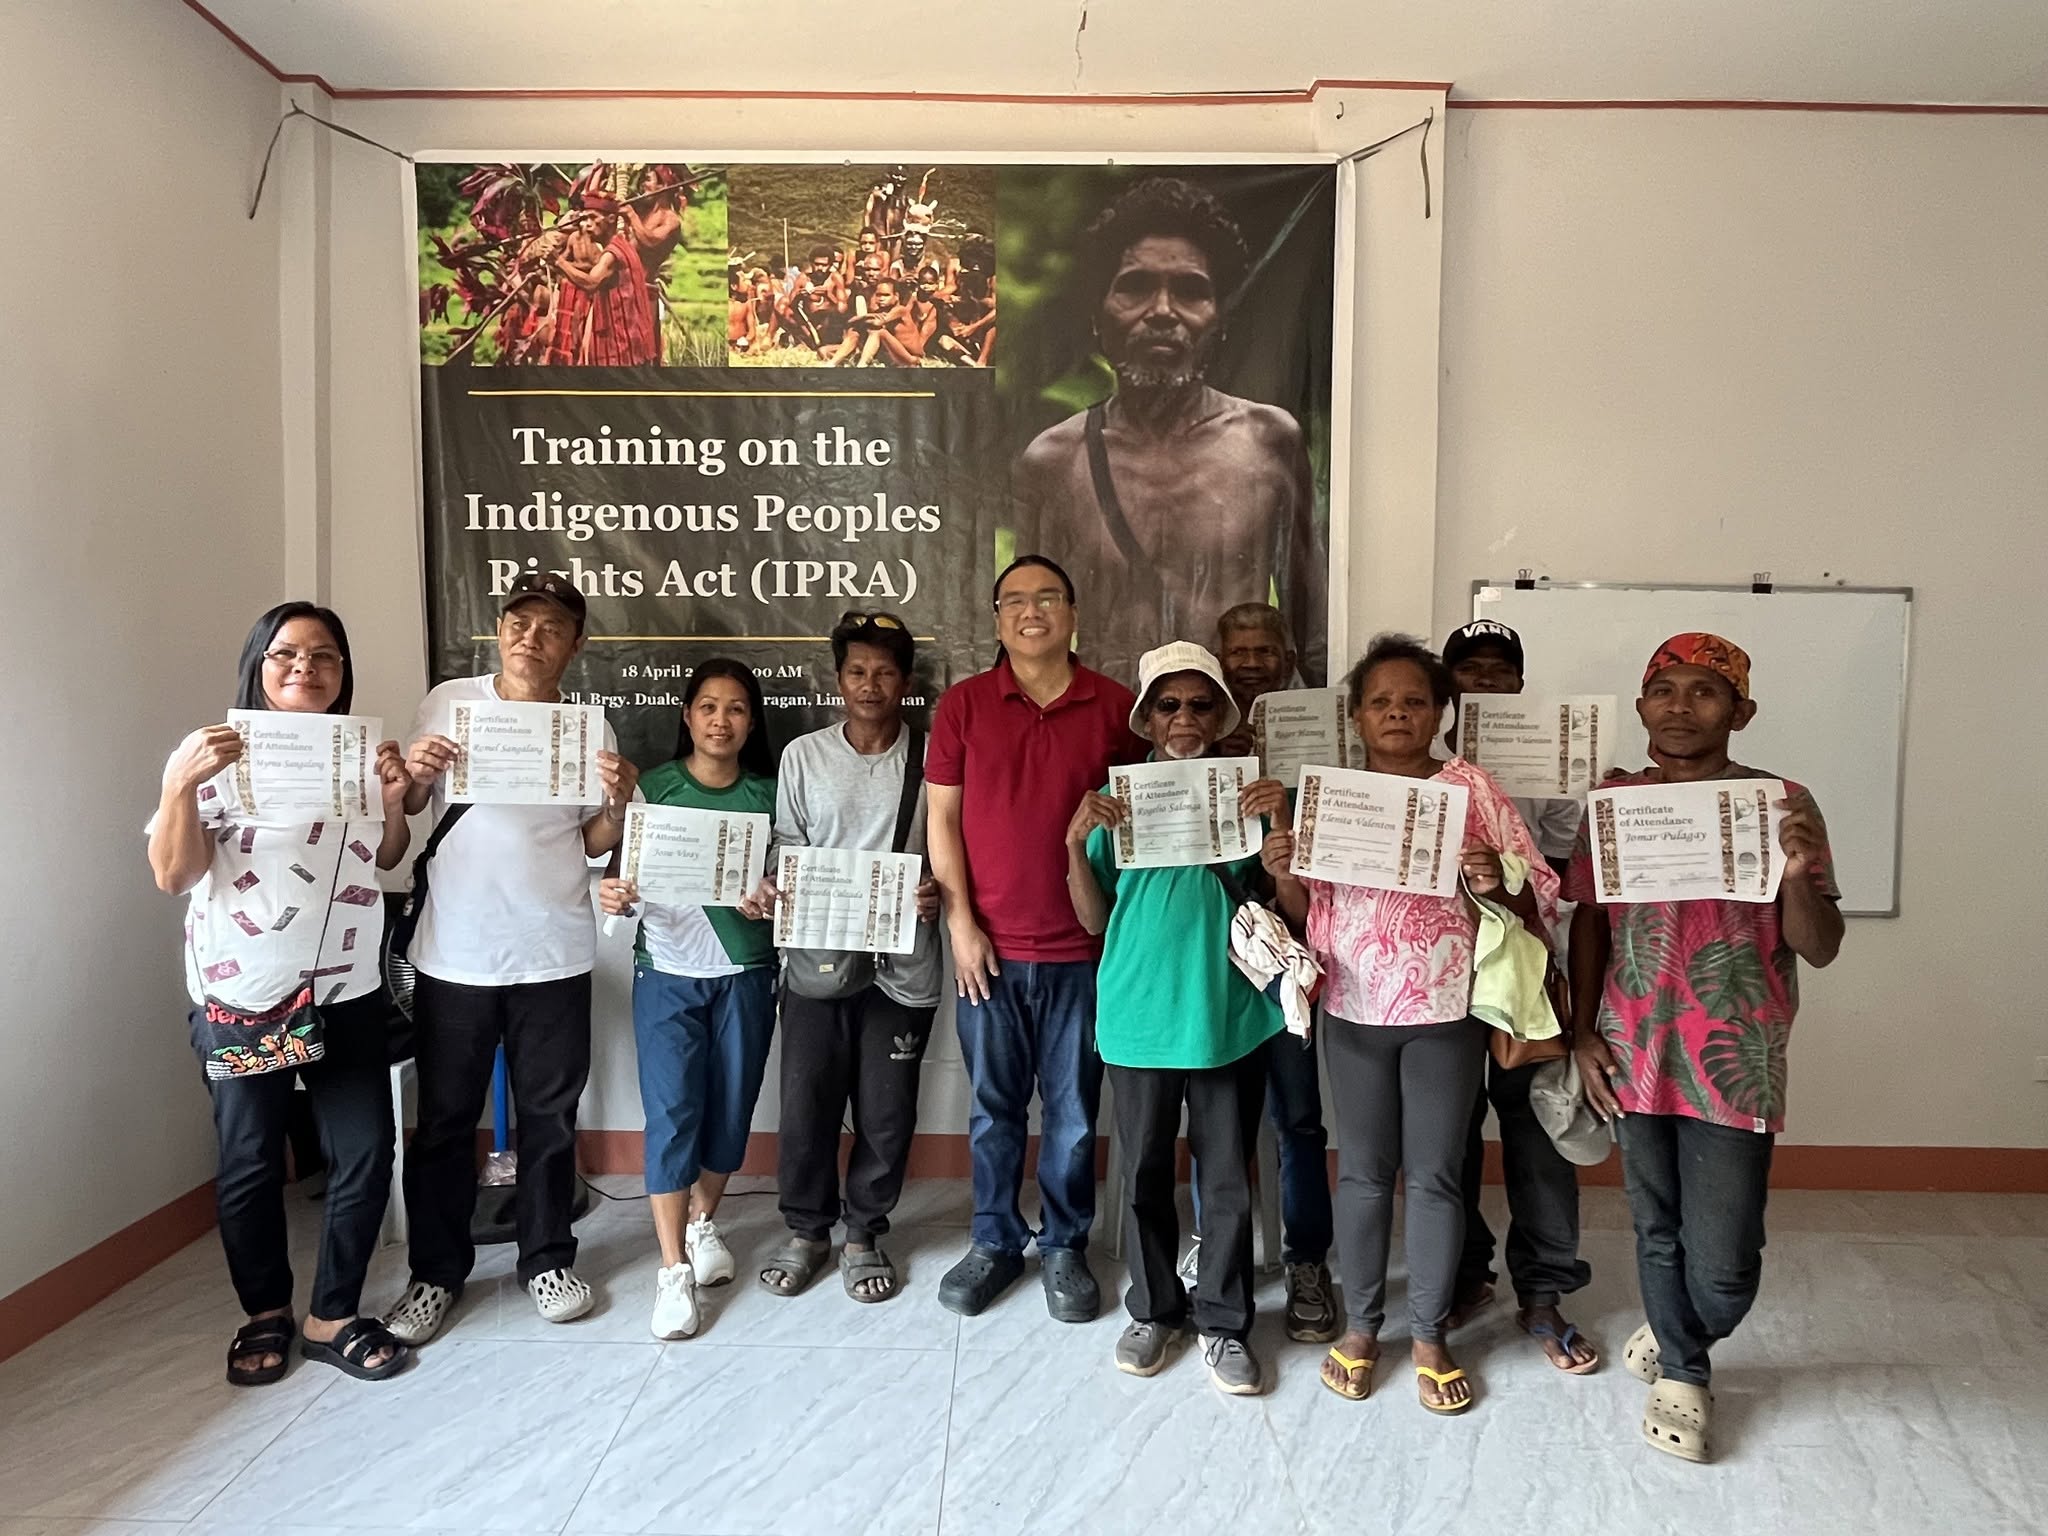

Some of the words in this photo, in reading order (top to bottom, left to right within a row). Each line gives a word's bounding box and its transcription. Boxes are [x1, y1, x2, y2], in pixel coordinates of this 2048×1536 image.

[512, 425, 726, 476] Training
[738, 437, 800, 466] on
[812, 427, 892, 466] the
[464, 491, 739, 541] Indigenous
[753, 493, 941, 542] Peoples
[656, 559, 737, 597] Act
[751, 558, 918, 604] (IPRA)
[622, 665, 638, 677] 18
[642, 665, 681, 680] April
[776, 665, 802, 678] AM
[590, 692, 630, 708] Brgy.
[474, 715, 518, 724] Certificate
[485, 726, 532, 735] Attendance
[1133, 780, 1176, 790] Certificate
[1145, 788, 1189, 799] Attendance
[1323, 786, 1370, 799] Certificate
[1321, 798, 1331, 806] of
[1333, 799, 1384, 813] Attendance
[1618, 805, 1674, 816] Certificate
[1619, 817, 1631, 827] of
[1633, 816, 1693, 827] Attendance
[1624, 832, 1657, 843] Jomar
